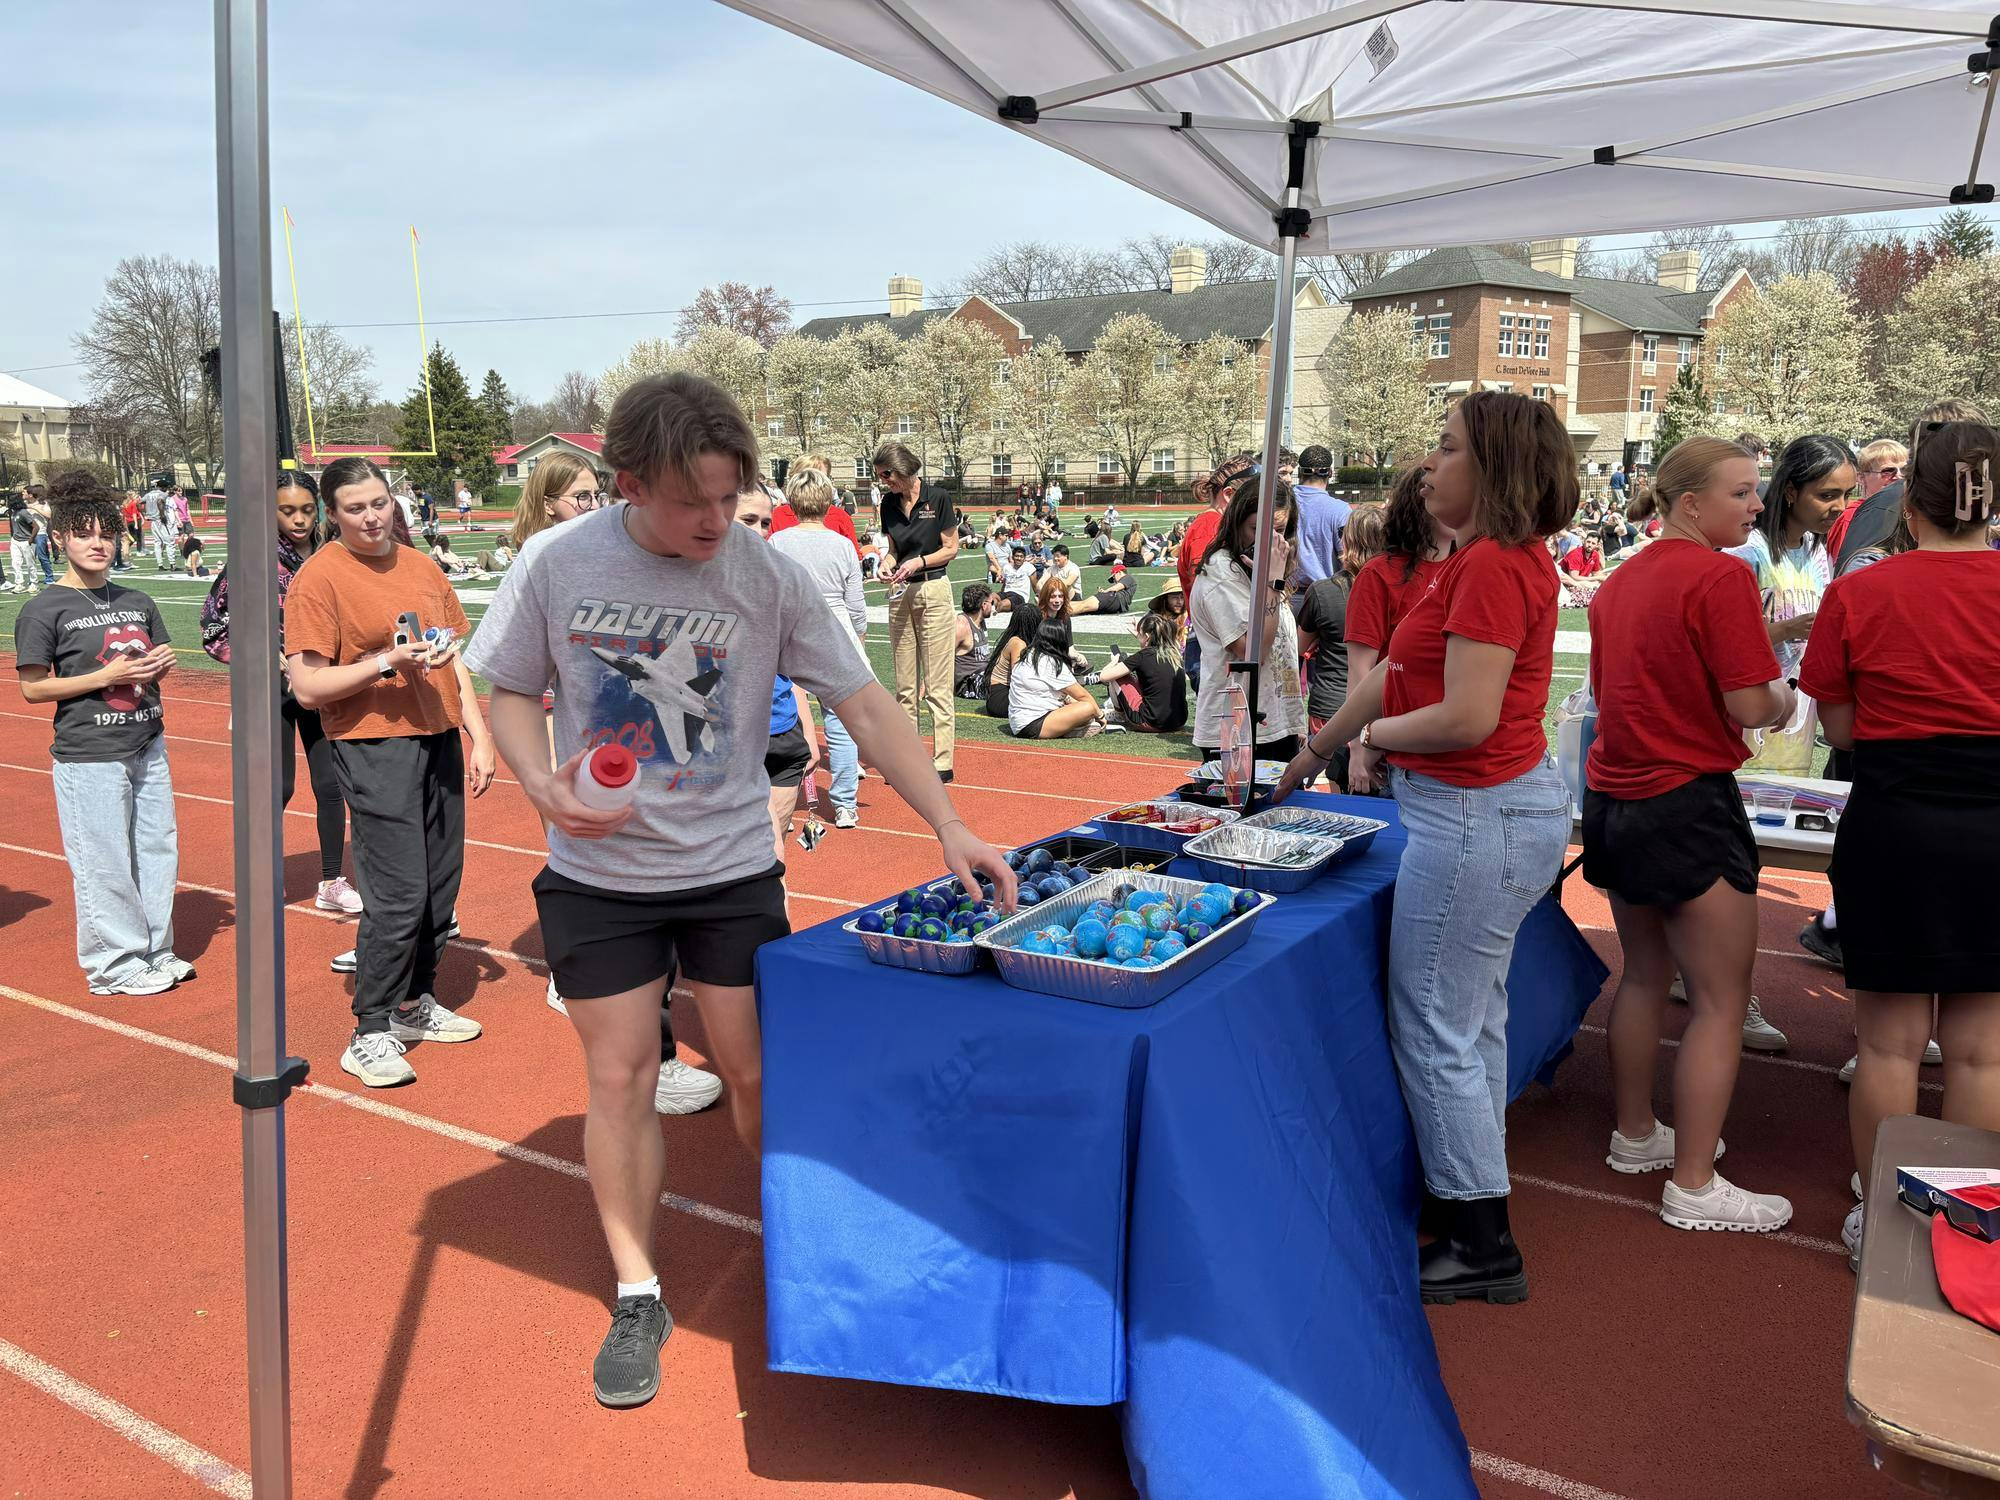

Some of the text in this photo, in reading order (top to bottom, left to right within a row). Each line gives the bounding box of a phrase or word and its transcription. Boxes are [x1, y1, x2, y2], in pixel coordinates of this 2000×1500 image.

[64, 620, 79, 631] THE
[77, 612, 120, 630] ROLLING
[569, 598, 739, 646] DAYTON
[568, 633, 627, 650] AIR
[94, 713, 127, 726] 1975
[135, 710, 150, 722] US
